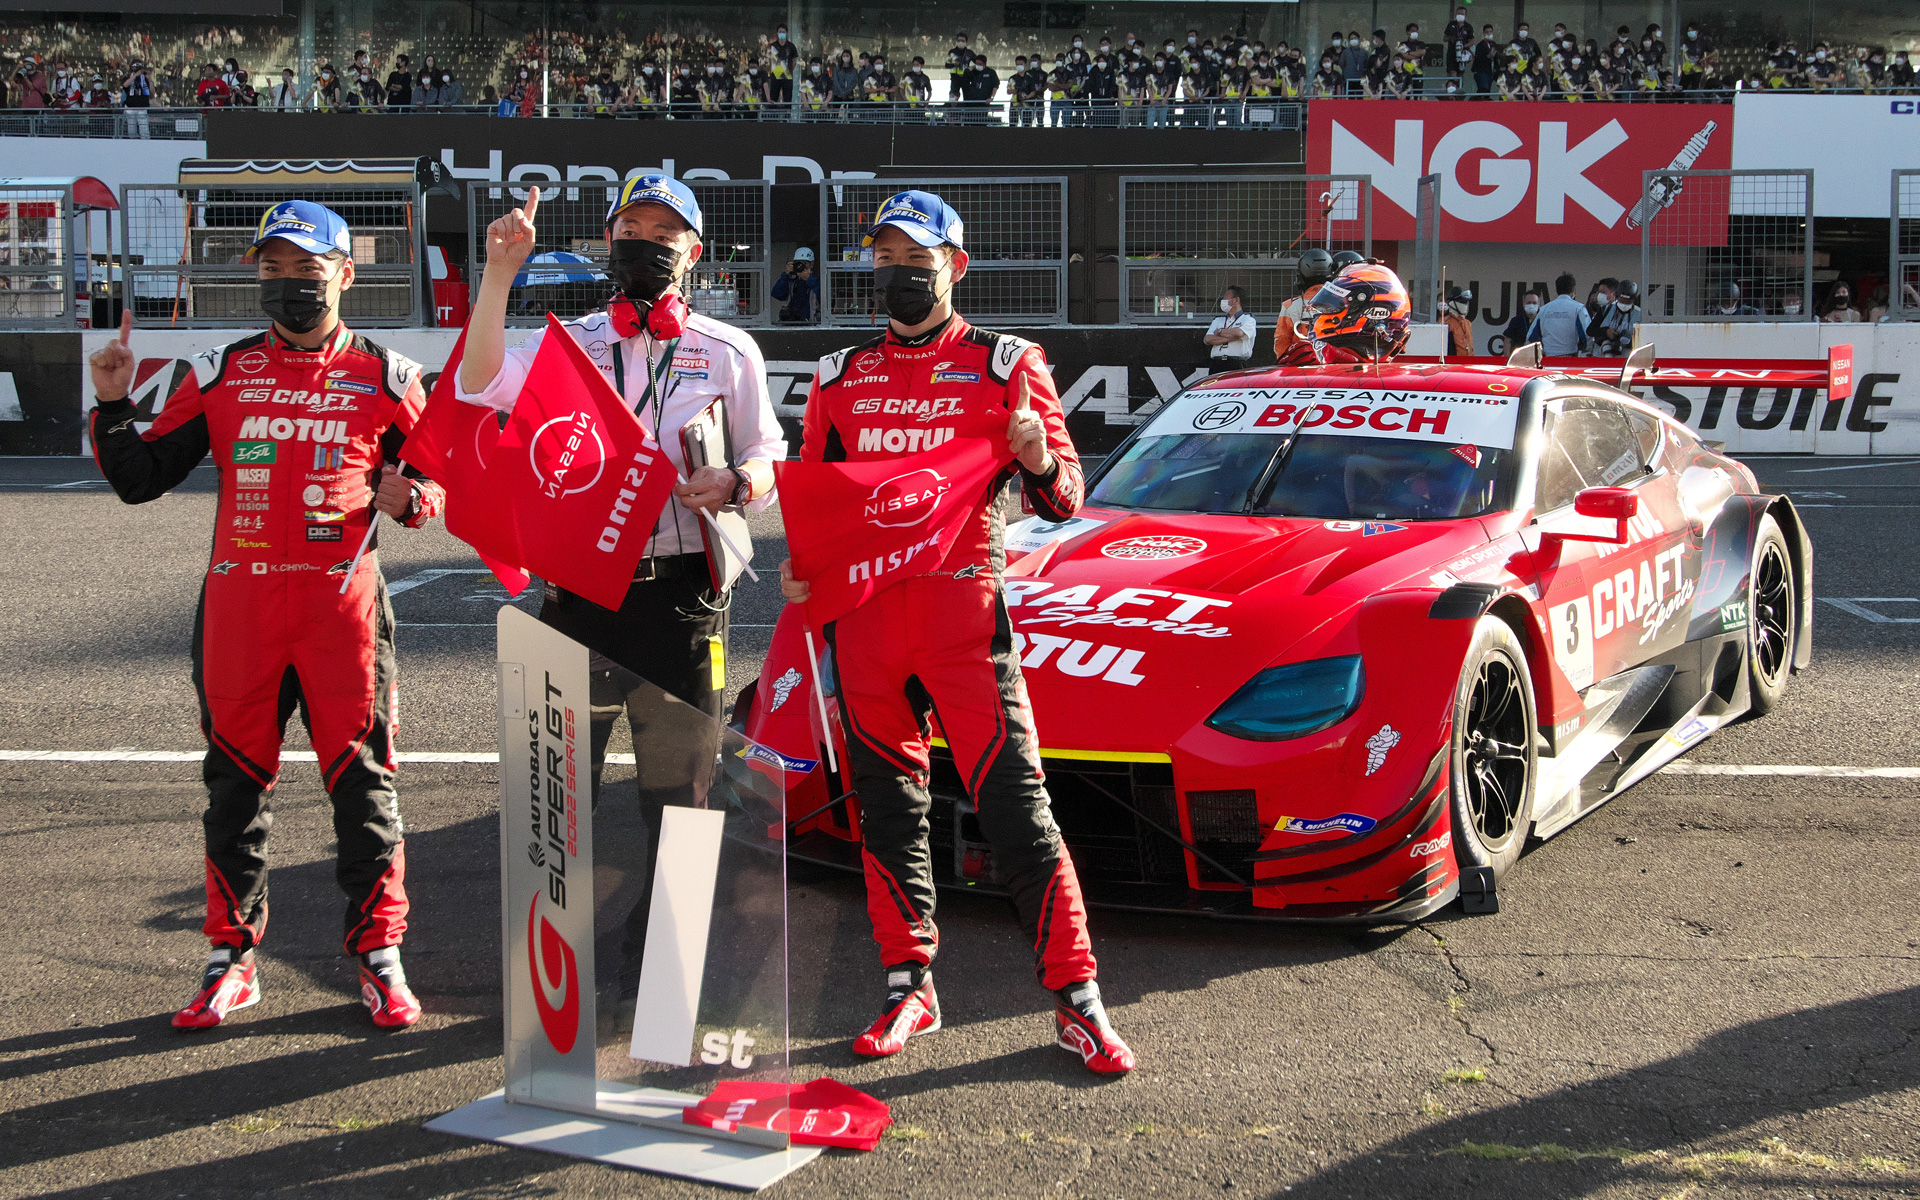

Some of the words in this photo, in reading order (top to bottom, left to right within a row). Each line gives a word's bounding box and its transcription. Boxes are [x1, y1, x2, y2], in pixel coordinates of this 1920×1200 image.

[1331, 118, 1629, 230] NGK
[631, 190, 685, 208] MICHELIN
[236, 357, 270, 366] NISSAN
[671, 358, 708, 368] MOTUL
[855, 355, 885, 367] NISSAN
[893, 349, 937, 359] NISSAN
[271, 389, 357, 407] CRAFT
[882, 397, 962, 415] CRAFT
[1252, 389, 1411, 402] NISSAN
[306, 402, 359, 415] Sports
[915, 407, 966, 423] Sports
[1252, 402, 1452, 436] BOSCH
[238, 415, 351, 444] MOTUL
[236, 493, 270, 501] MEGA
[236, 502, 270, 511] VISION
[864, 482, 952, 517] NISSAN
[1447, 555, 1476, 573] NISMO
[1471, 544, 1501, 565] SPORTS
[1592, 541, 1686, 639] CRAFT
[1018, 604, 1233, 638] Sports
[1638, 577, 1695, 646] Sports
[1720, 601, 1746, 623] NTK
[1566, 603, 1579, 655] 3
[545, 670, 564, 742] GT
[564, 706, 577, 793] SERIES
[529, 708, 541, 840] AUTOBACS
[546, 744, 567, 911] SUPER
[565, 795, 578, 858] 2022
[1305, 817, 1364, 831] MICHELIN
